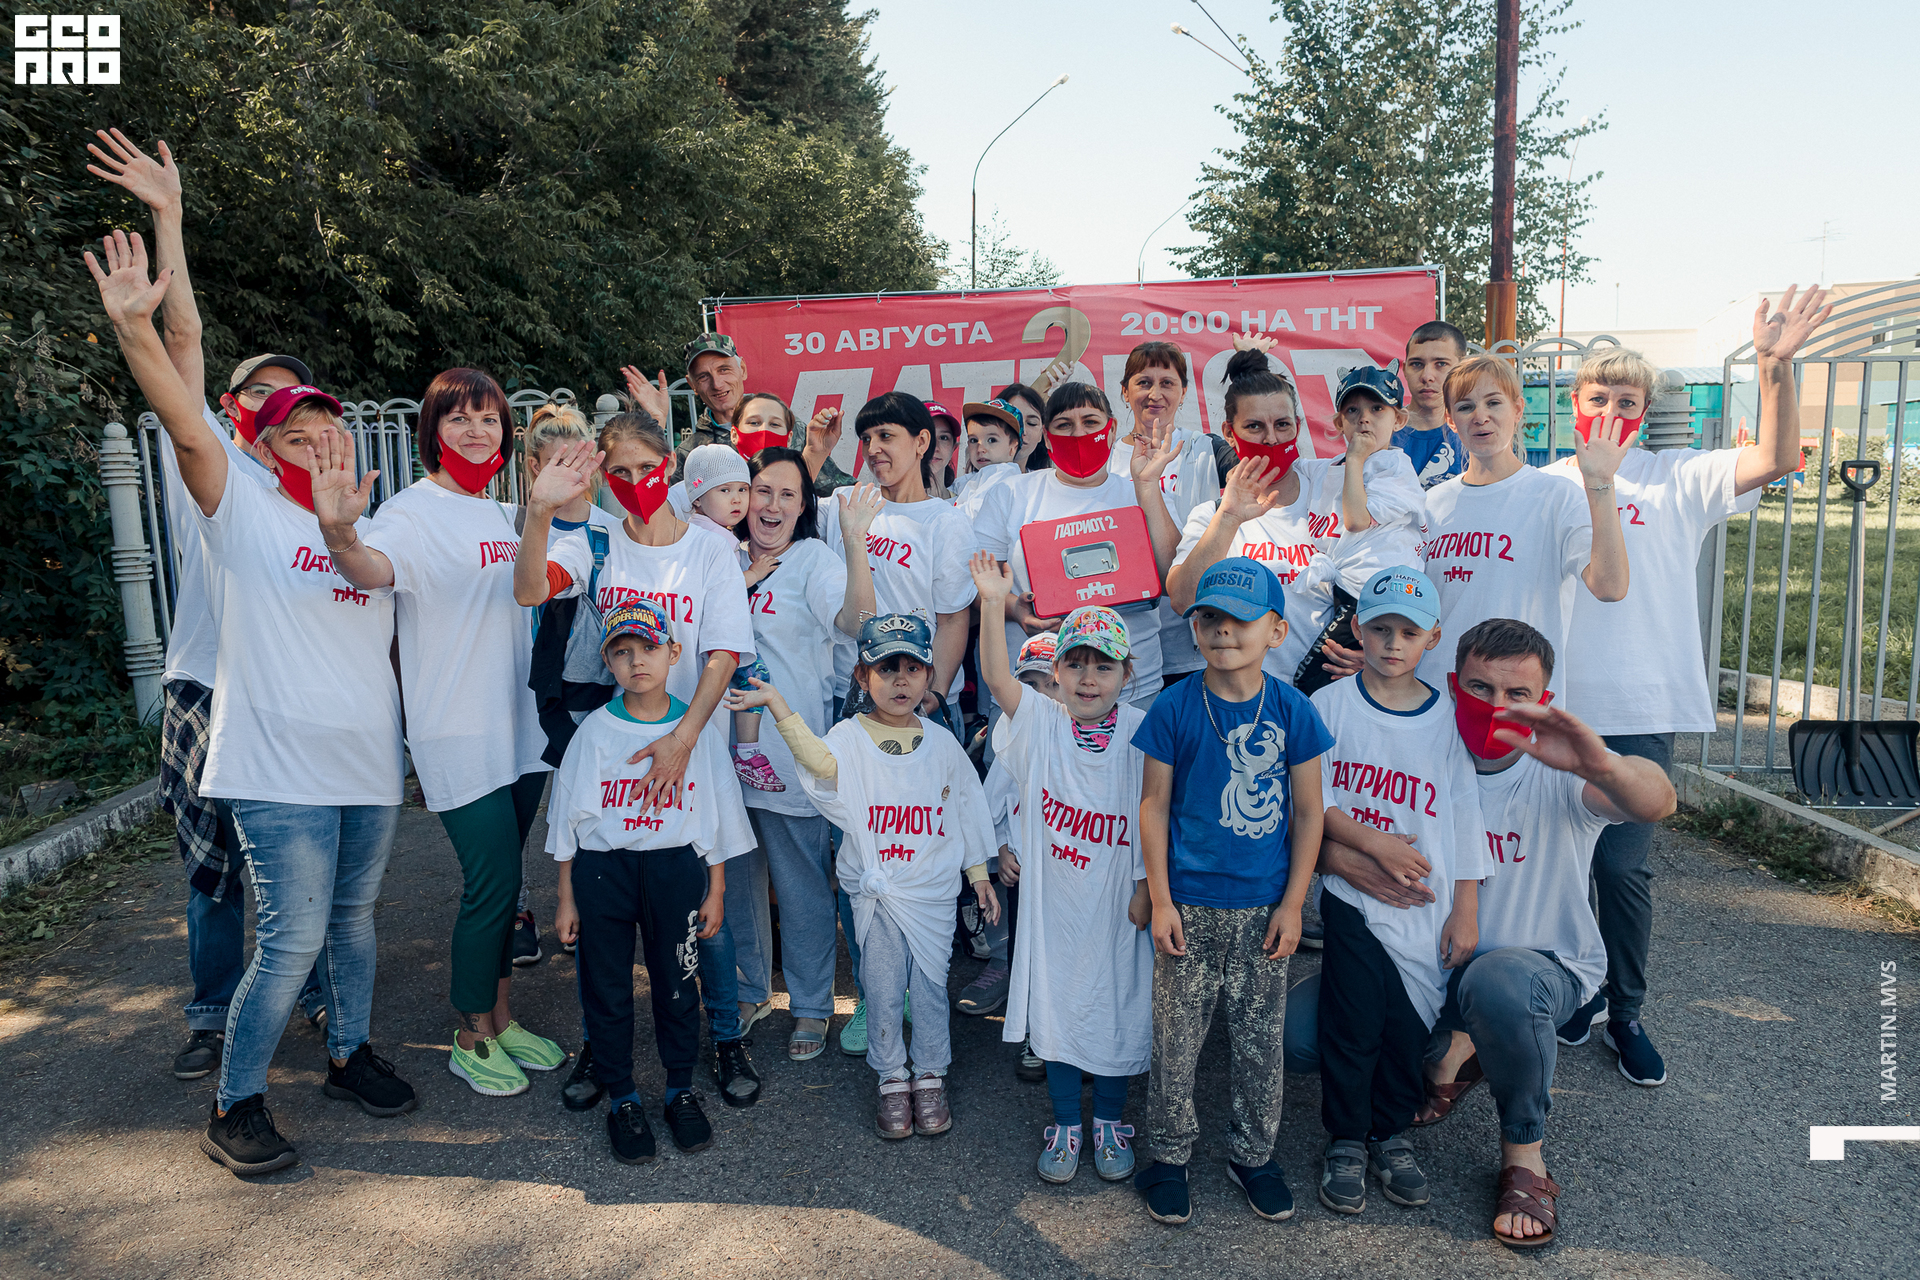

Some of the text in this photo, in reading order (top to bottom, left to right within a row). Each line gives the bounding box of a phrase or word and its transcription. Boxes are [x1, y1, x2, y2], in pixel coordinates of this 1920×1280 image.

[1121, 305, 1383, 336] 20:00 НА ТНТ
[784, 320, 994, 356] 30 АВГУСТА
[1627, 503, 1646, 526] 2
[1054, 515, 1119, 541] ПАТРИОТ 2
[897, 543, 912, 569] 2
[1498, 534, 1515, 562] 2
[1203, 571, 1256, 592] RUSSIA
[1443, 566, 1474, 583] ТНТ
[332, 586, 371, 607] ТНТ
[761, 590, 777, 616] 2
[1076, 581, 1117, 602] ТНТ
[682, 595, 694, 624] 2
[1424, 781, 1437, 818] 2
[622, 815, 664, 832] ТНТ
[867, 805, 932, 836] АТРИОТ
[1117, 815, 1130, 847] 2
[1351, 807, 1394, 832] ТНТ
[878, 843, 915, 863] ТНТ
[1050, 843, 1092, 870] ТНТ
[1506, 831, 1526, 863] 2
